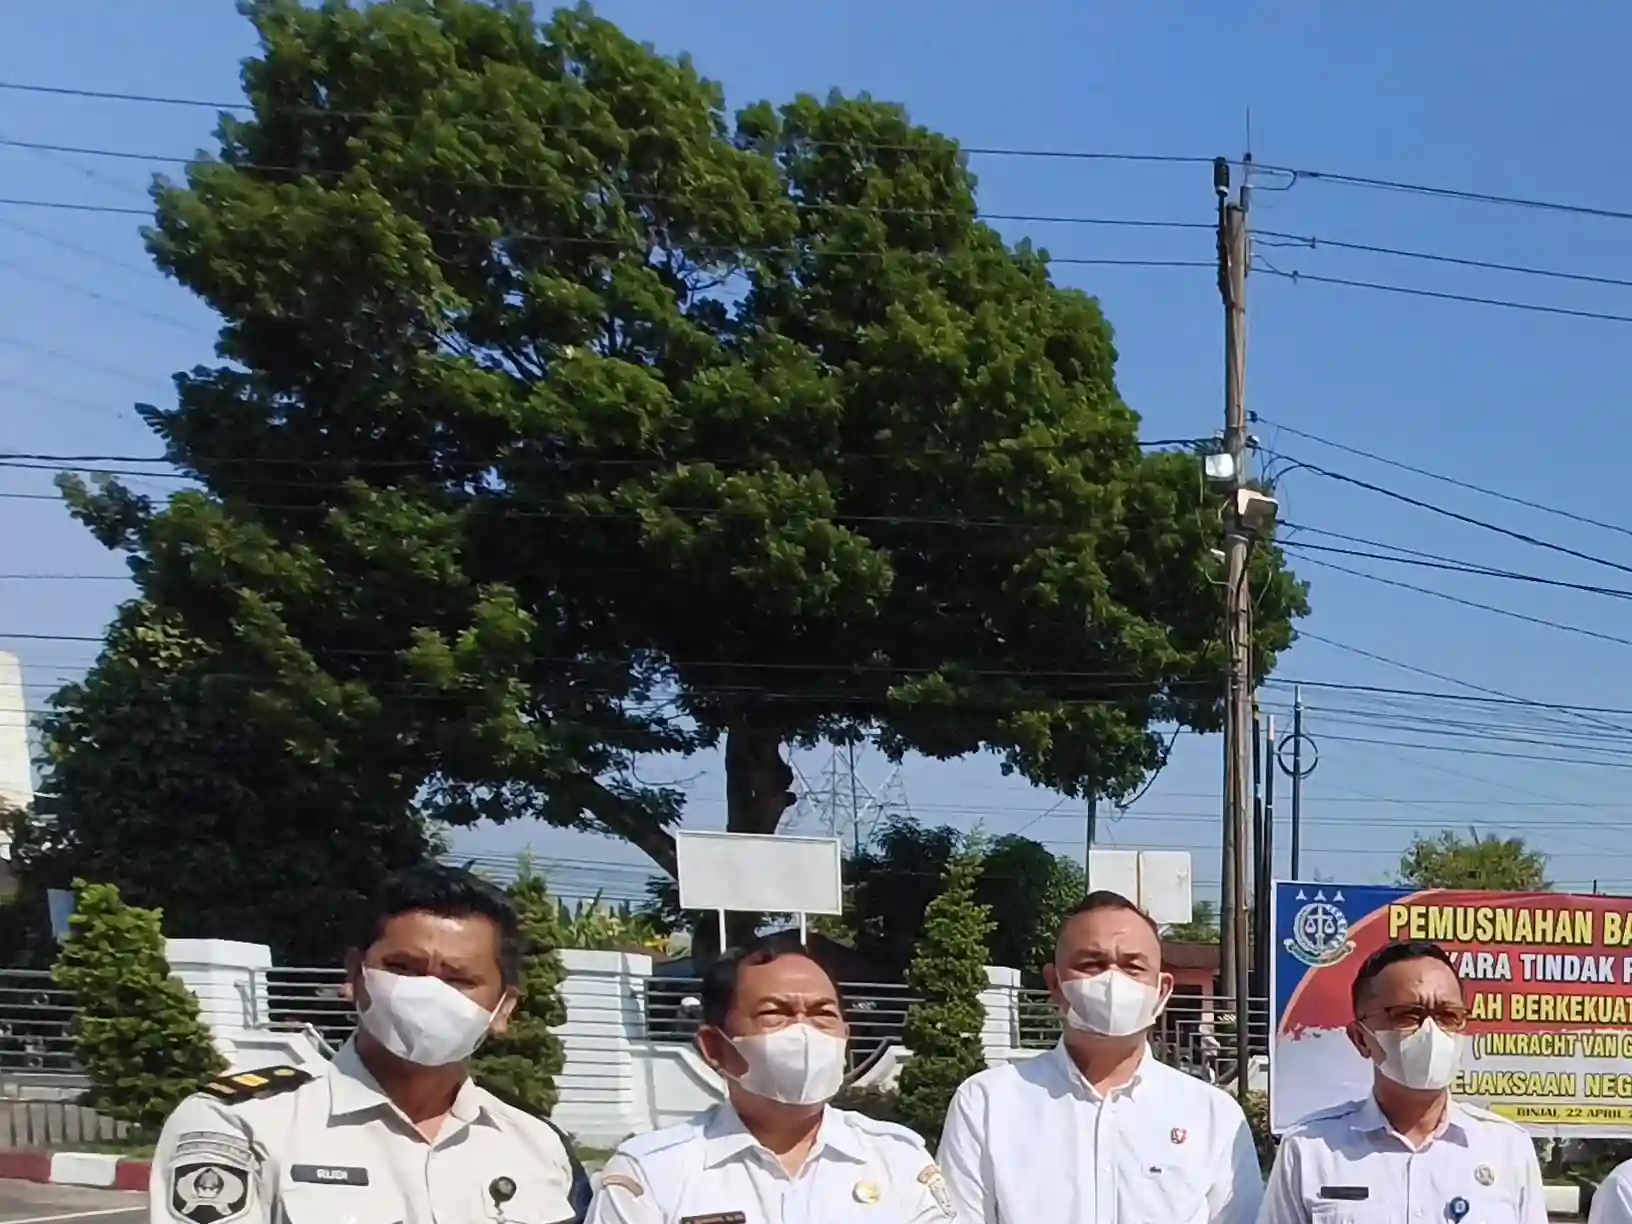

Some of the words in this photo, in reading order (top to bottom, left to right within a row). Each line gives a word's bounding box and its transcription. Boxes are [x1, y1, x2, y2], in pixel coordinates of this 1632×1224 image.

[1388, 904, 1593, 945] PEMUSNAHAN
[1519, 953, 1615, 983] TINDAK
[1485, 1032, 1577, 1056] INKRACHT
[1582, 1034, 1618, 1058] VAN
[1451, 1069, 1576, 1097] EJAKSAAN
